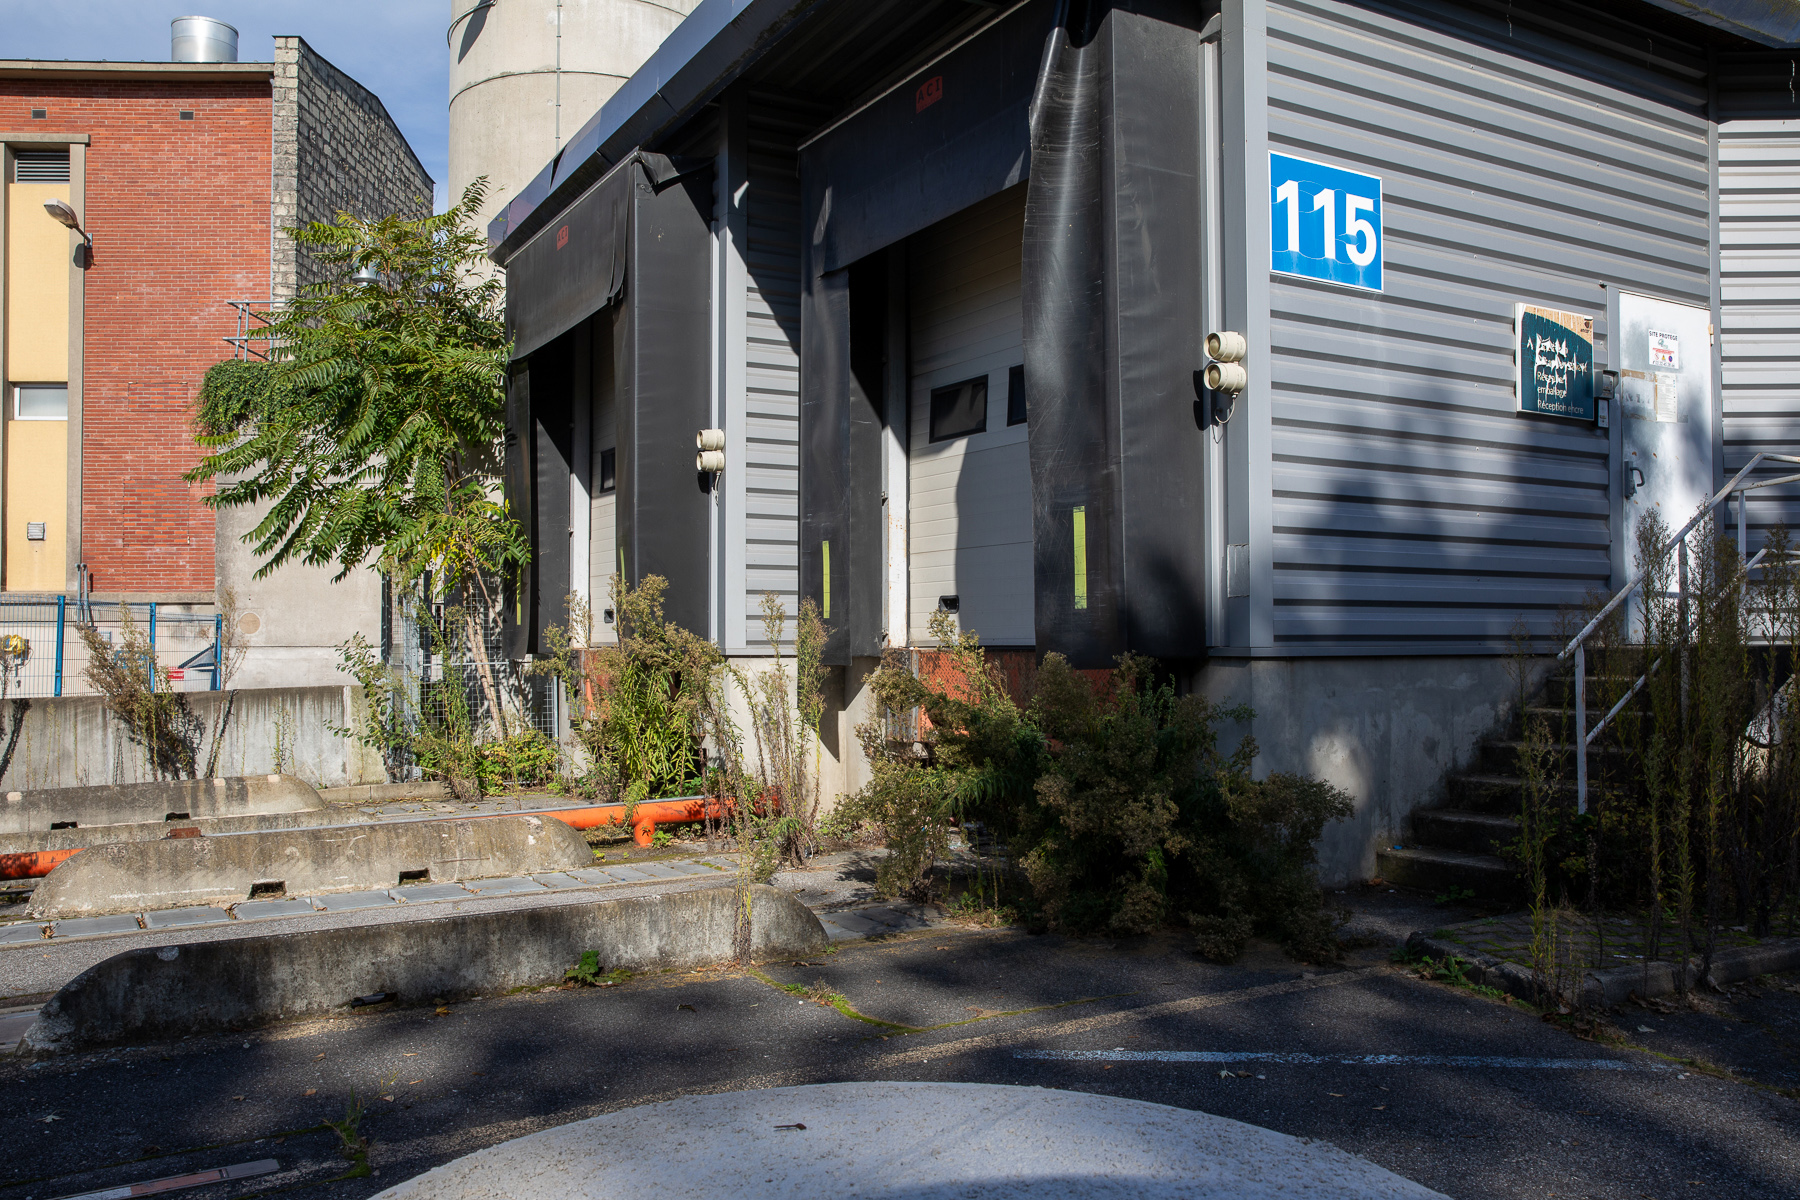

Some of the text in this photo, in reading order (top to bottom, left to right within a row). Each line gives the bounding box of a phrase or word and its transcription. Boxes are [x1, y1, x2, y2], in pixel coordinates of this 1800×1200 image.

[917, 78, 940, 104] ACI
[1276, 179, 1377, 267] 115
[1537, 400, 1584, 415] Réception encre
